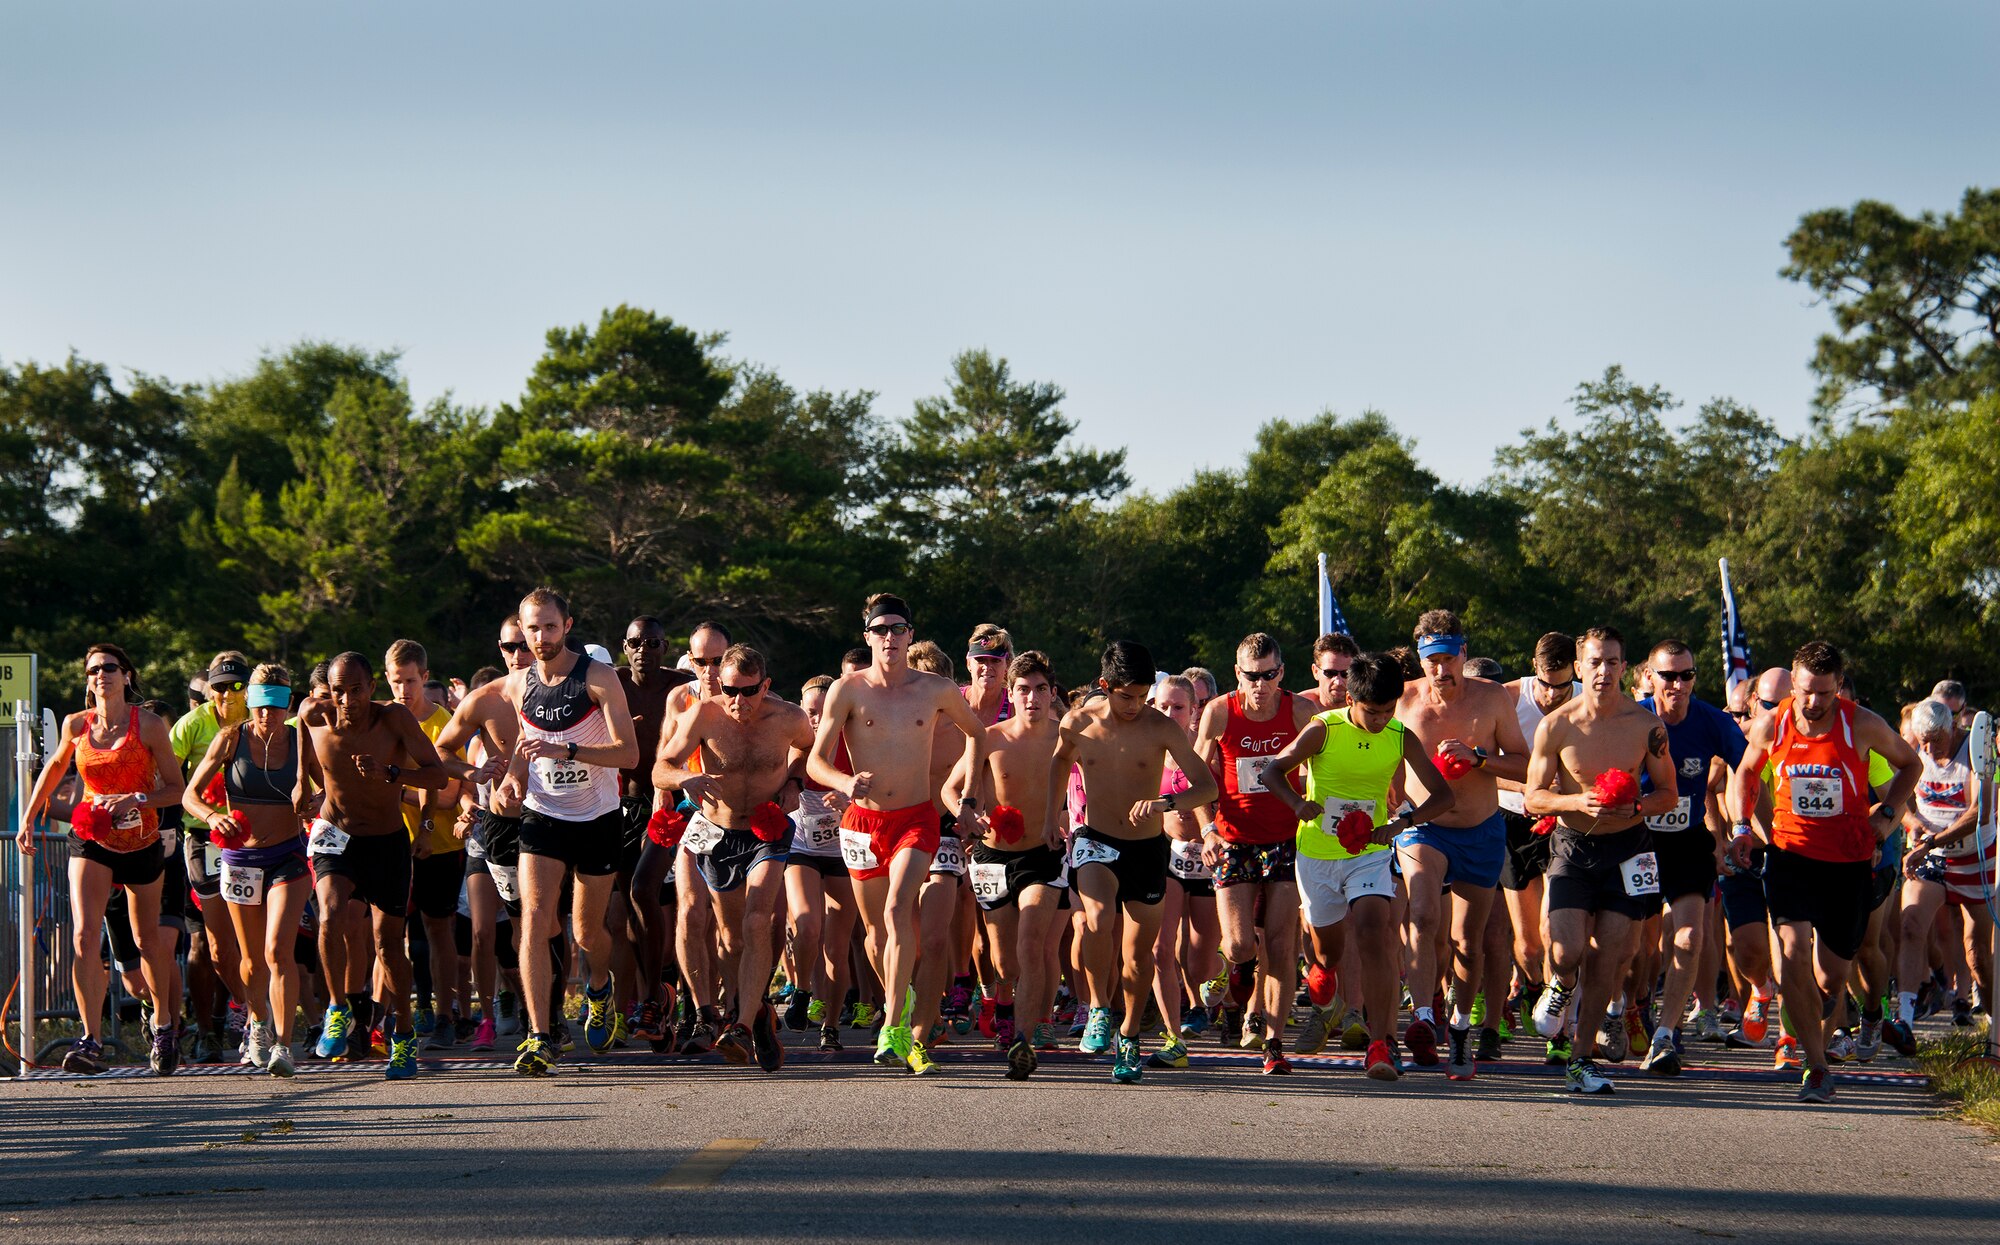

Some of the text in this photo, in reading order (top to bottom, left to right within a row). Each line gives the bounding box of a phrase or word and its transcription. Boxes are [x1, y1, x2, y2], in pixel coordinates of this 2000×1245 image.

[535, 704, 573, 721] GWTC
[1240, 736, 1281, 752] GWTC
[545, 769, 589, 785] 1222
[1785, 763, 1842, 778] NWFTC
[1798, 796, 1835, 810] 844
[844, 848, 867, 862] 791
[1174, 858, 1204, 873] 897
[225, 881, 255, 898] 760
[973, 882, 999, 896] 567
